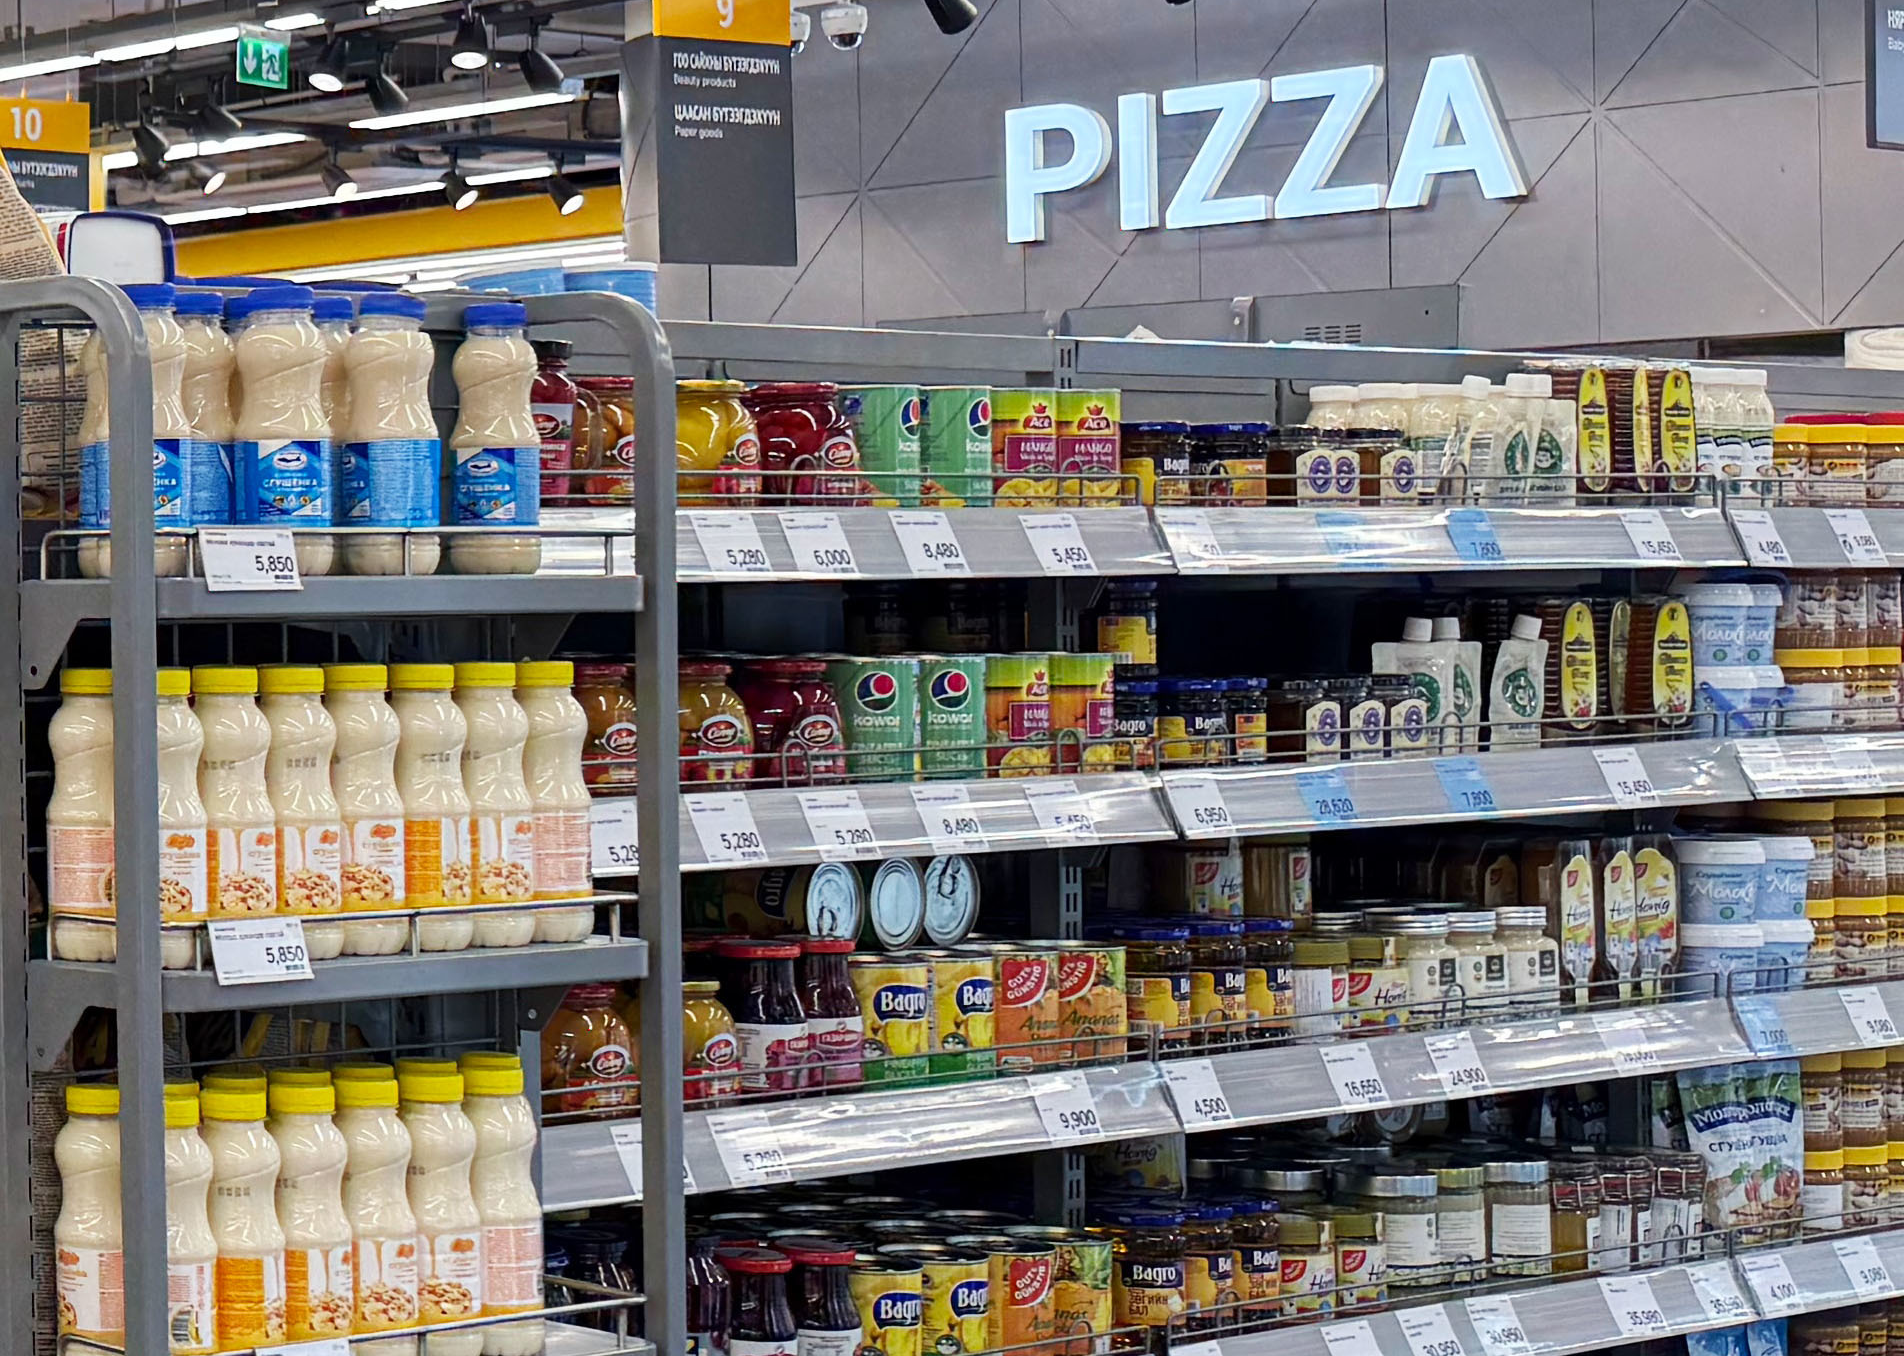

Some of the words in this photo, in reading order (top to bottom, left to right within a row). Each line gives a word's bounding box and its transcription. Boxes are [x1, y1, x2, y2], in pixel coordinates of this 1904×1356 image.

[11, 107, 41, 141] 10
[1005, 54, 1531, 244] PIZZA
[255, 555, 294, 574] 5,850
[727, 550, 766, 567] 5,280
[813, 549, 851, 566] 6,000
[720, 831, 760, 849] 5,280
[265, 943, 305, 966] 5,850
[1344, 1077, 1383, 1097] 16,650
[1194, 1097, 1227, 1116] 4,500
[1059, 1109, 1097, 1130] 9,900
[1133, 1264, 1176, 1284] Bagro
